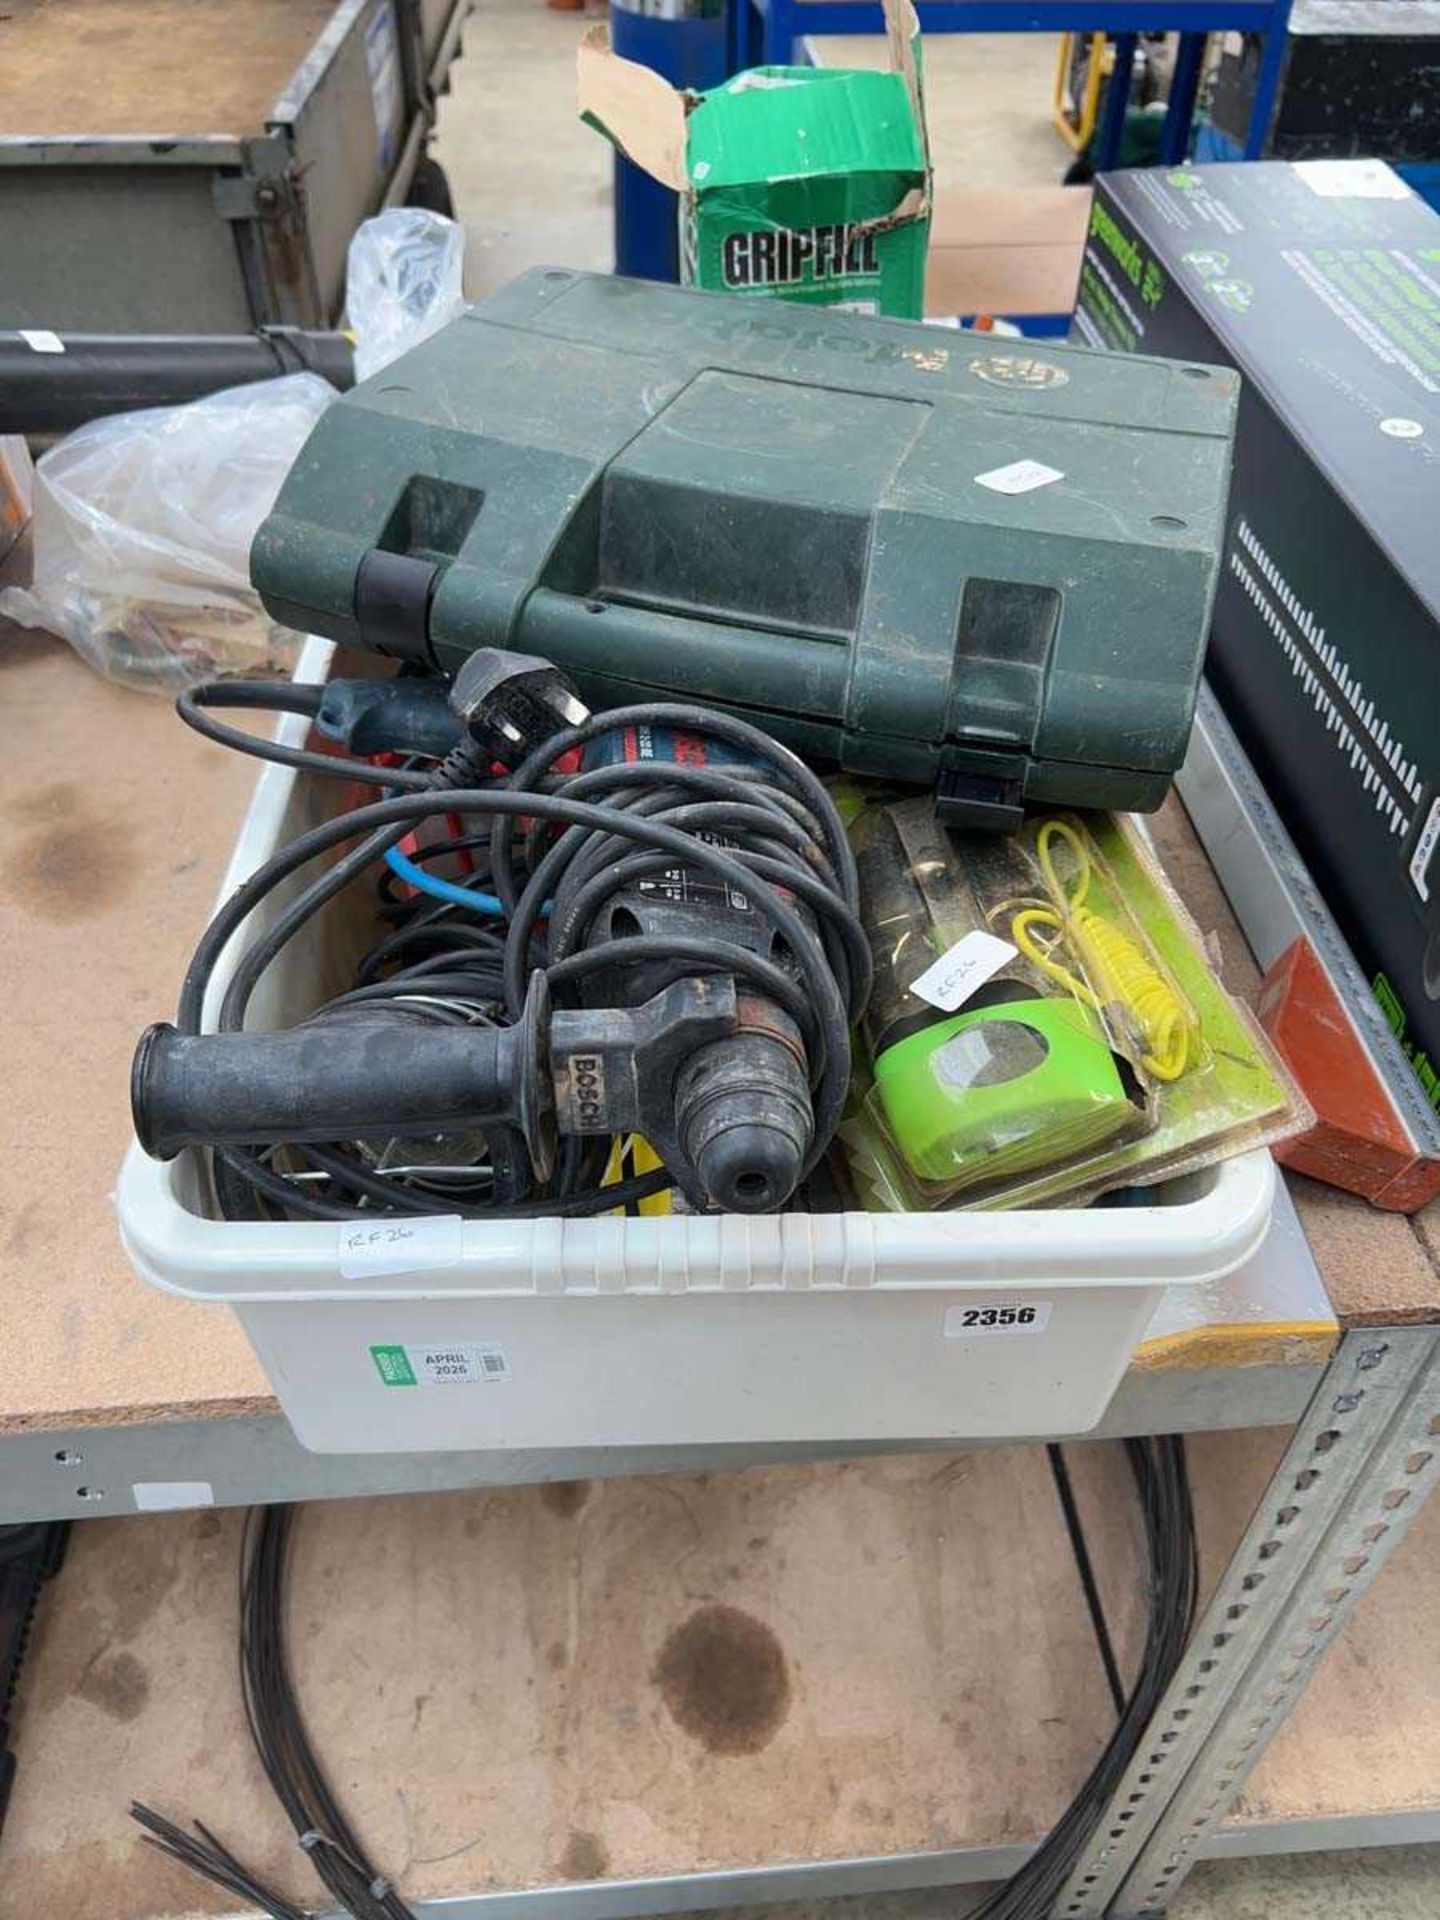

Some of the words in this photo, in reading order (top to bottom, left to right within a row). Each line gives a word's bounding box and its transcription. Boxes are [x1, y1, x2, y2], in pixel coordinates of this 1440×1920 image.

[723, 223, 880, 287] GRIPFILL
[575, 1059, 601, 1128] BOSCH
[961, 1306, 1037, 1327] 2356
[425, 1354, 469, 1365] APRIL
[434, 1364, 468, 1376] 2026
